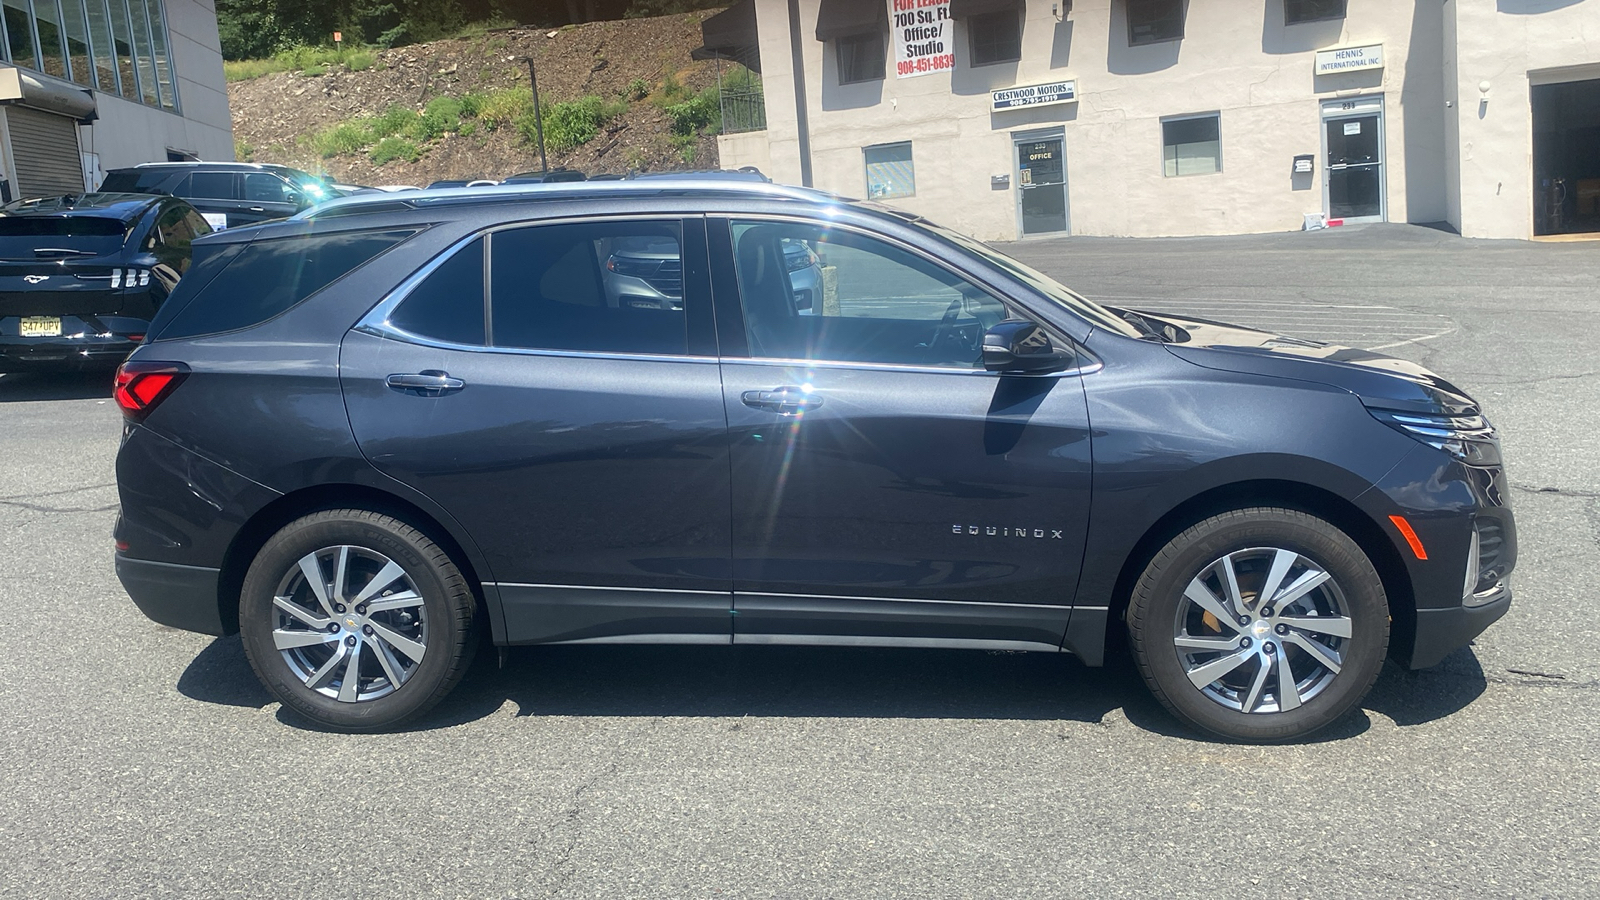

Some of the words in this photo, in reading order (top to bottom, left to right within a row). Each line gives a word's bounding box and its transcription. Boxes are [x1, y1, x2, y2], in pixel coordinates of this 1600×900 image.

[917, 0, 950, 8] LEA
[894, 12, 915, 28] 700
[916, 10, 935, 24] Sq.
[904, 23, 943, 42] Office/
[906, 41, 944, 58] Studio
[1335, 49, 1363, 60] HENNIS
[897, 53, 956, 75] 908-451-8839
[1320, 59, 1367, 70] INTERNATIONAL
[1368, 57, 1379, 65] INC
[993, 88, 1035, 102] CRESTWOOD
[1037, 84, 1067, 95] MOTORS
[1029, 152, 1052, 161] OFFICE
